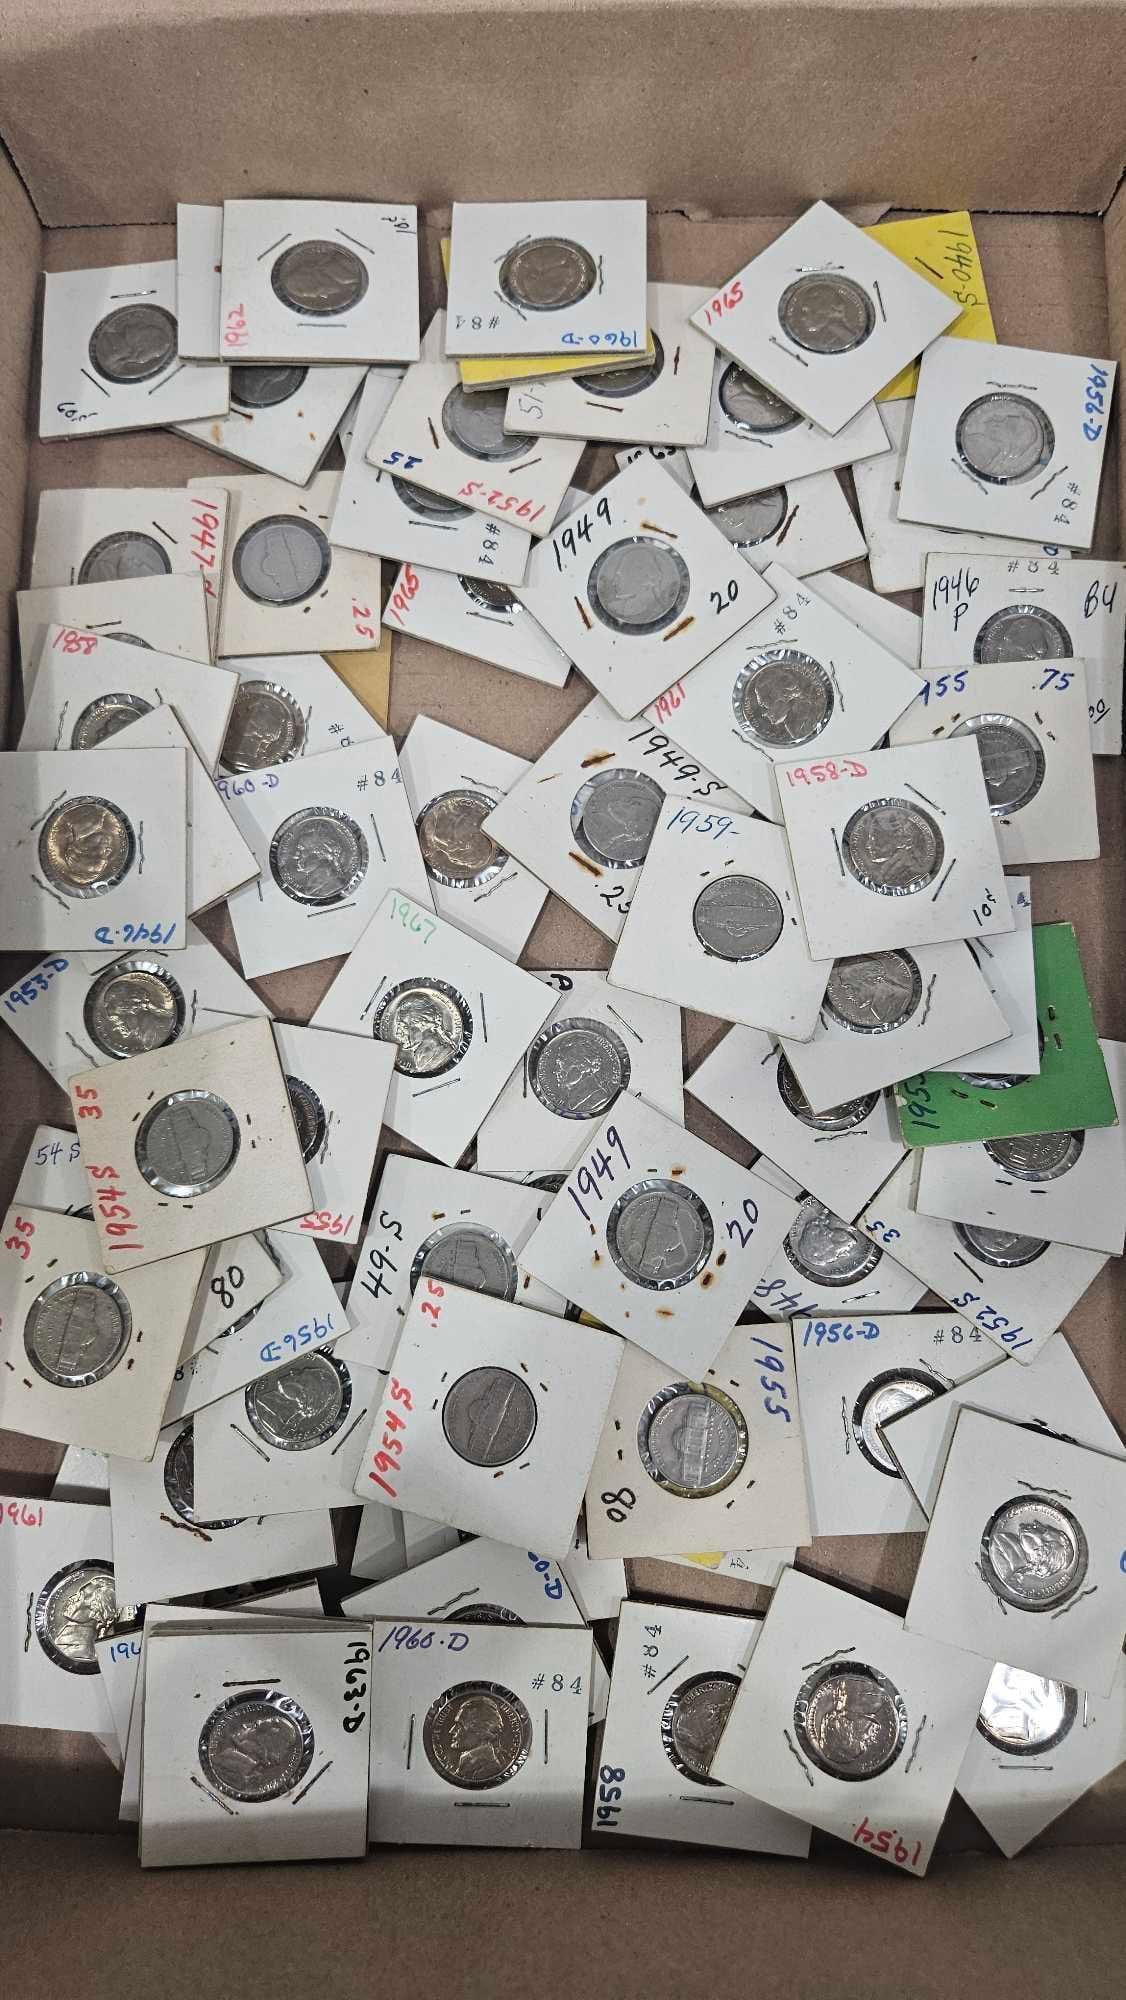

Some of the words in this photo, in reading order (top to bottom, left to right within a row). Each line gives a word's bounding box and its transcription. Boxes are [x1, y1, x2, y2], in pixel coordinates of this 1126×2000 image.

[938, 229, 979, 307] 1940-S
[224, 303, 248, 348] 1962
[704, 281, 744, 325] 1965
[561, 330, 639, 347] 1960-D
[1081, 363, 1109, 442] 1956-D
[457, 480, 546, 523] 1952-S
[190, 498, 220, 568] 1947
[552, 497, 612, 573] 1949
[389, 562, 420, 626] 1965
[709, 579, 740, 615] 20
[932, 567, 981, 610] 1946
[953, 602, 969, 632] P
[654, 683, 687, 724] 1961
[785, 760, 868, 787] 1958-D
[390, 897, 437, 944] 1967
[3, 958, 70, 1013] 1953-D
[75, 1085, 104, 1120] 35
[568, 1125, 632, 1221] 1949
[4, 1216, 36, 1261] 35
[726, 1198, 760, 1249] 20
[210, 1265, 246, 1310] 80
[260, 1313, 336, 1362] 1956-D
[802, 1320, 881, 1348] 1956-D
[750, 1336, 792, 1424] 1955
[531, 1671, 583, 1696] #84
[596, 1763, 627, 1827] 1958
